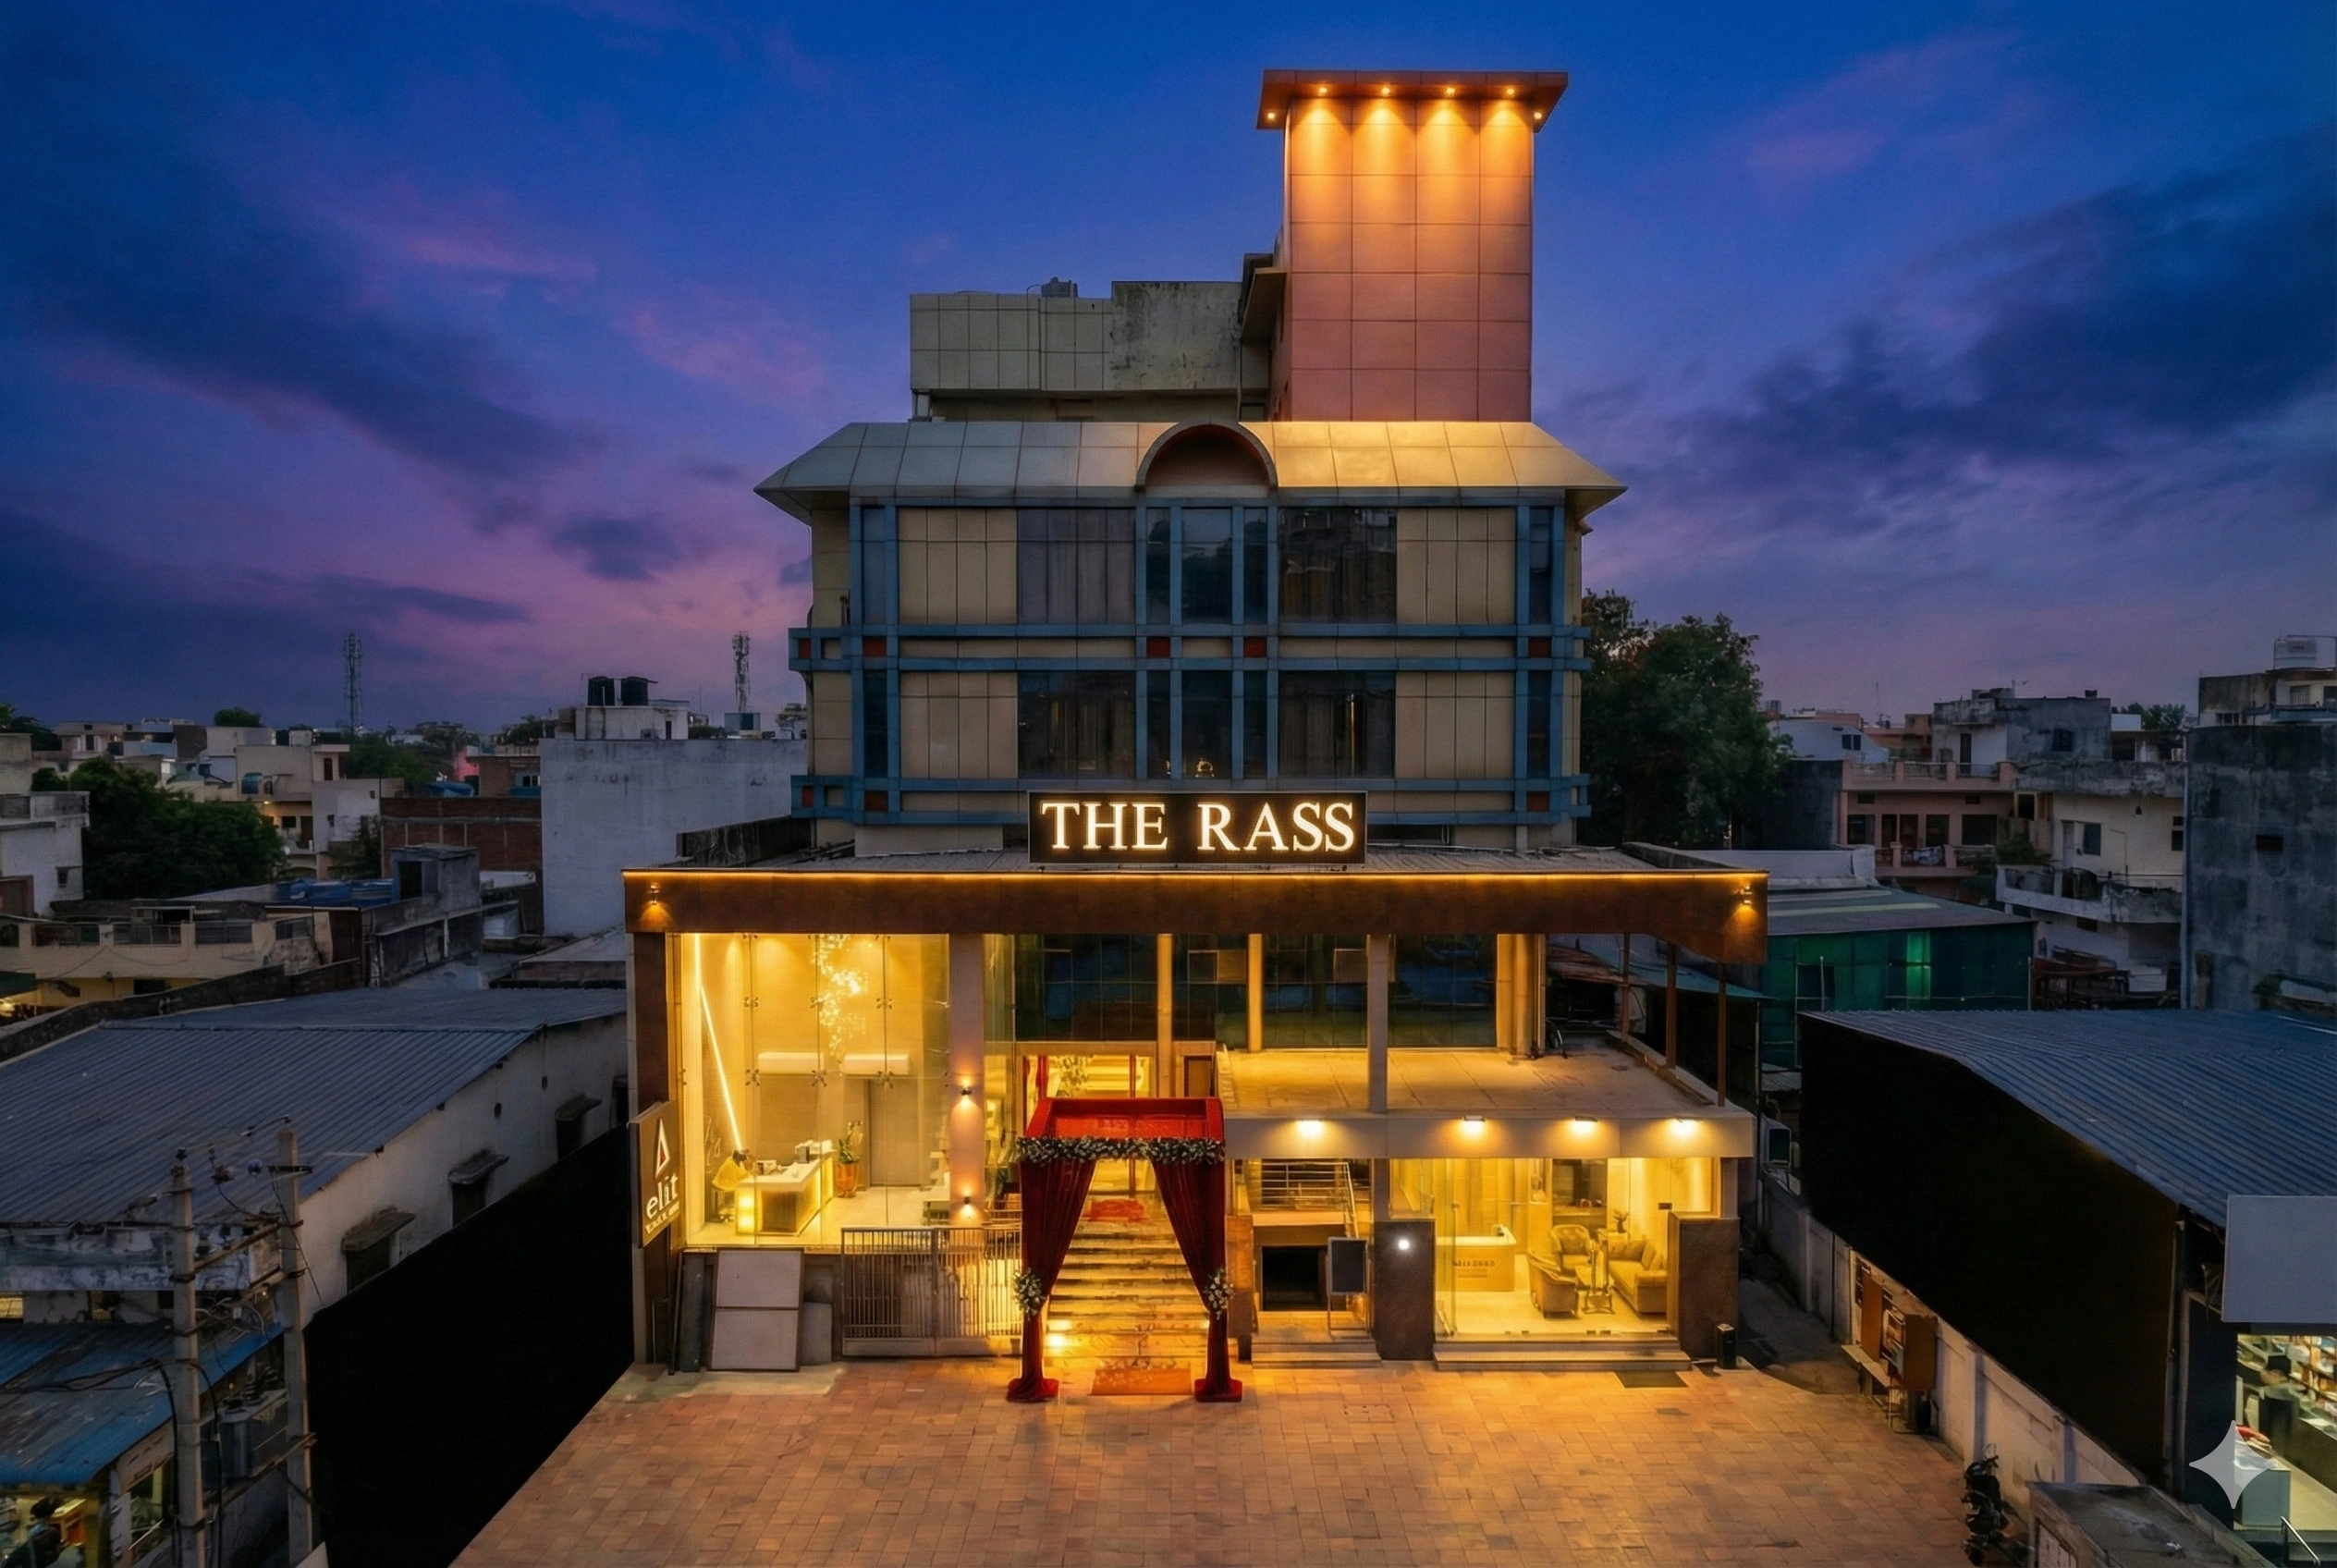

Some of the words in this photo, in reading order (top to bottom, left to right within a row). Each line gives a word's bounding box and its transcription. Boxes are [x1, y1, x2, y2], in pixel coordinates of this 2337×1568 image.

[1041, 802, 1168, 850] THE
[1197, 802, 1355, 851] RASS
[646, 1173, 679, 1219] elit
